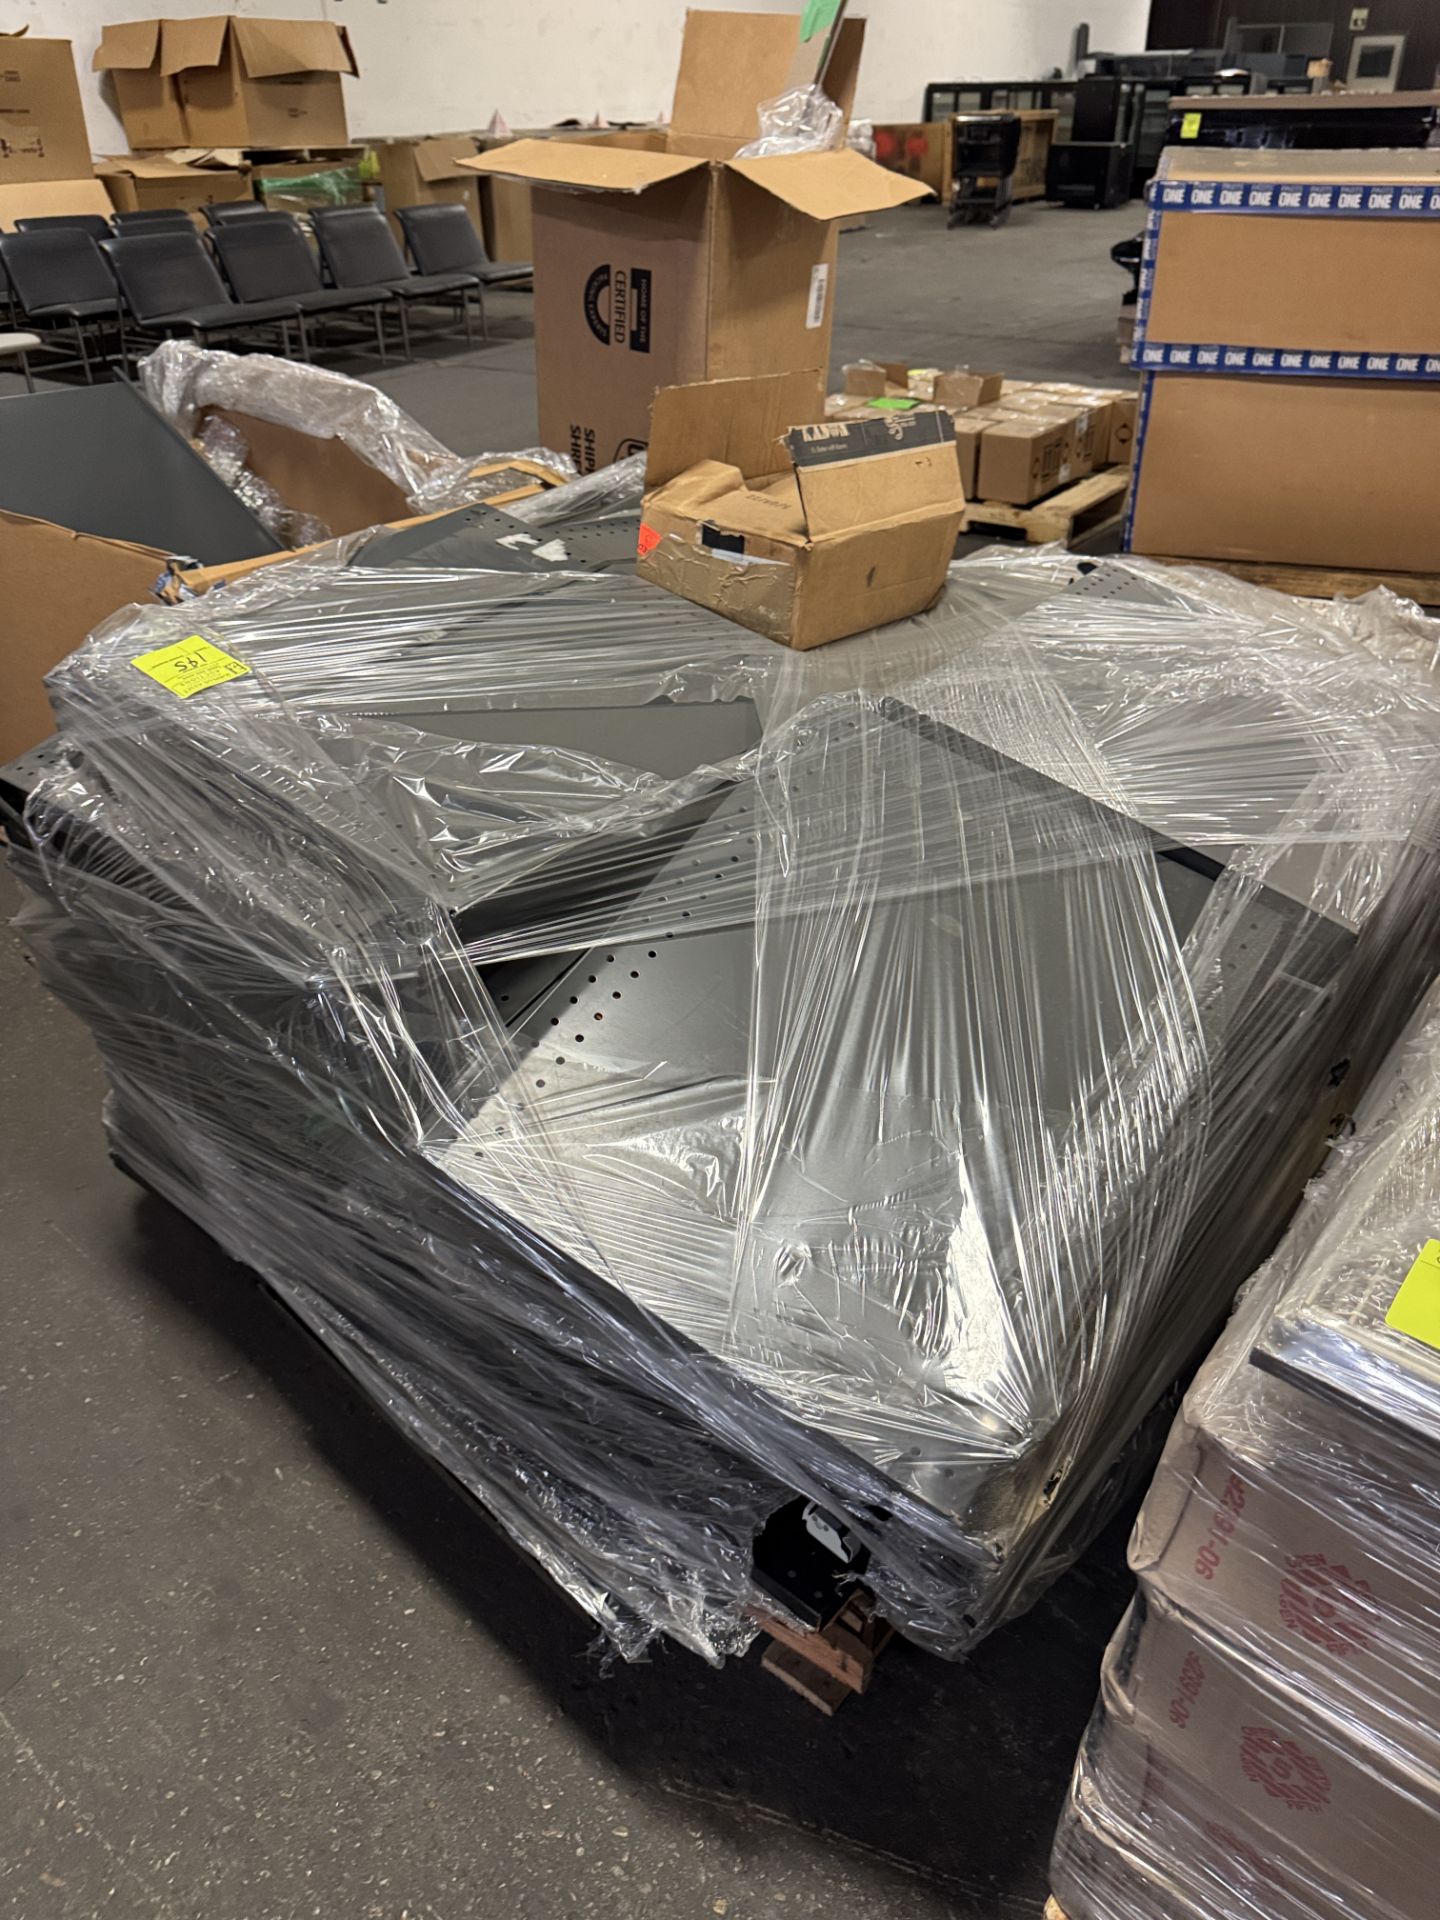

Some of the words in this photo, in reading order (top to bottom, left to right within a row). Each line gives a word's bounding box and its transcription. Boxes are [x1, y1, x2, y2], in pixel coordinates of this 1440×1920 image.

[1162, 188, 1185, 202] ONE
[1190, 189, 1214, 204] ONE
[1220, 190, 1242, 205] ONE
[1249, 191, 1272, 206] ONE
[1278, 192, 1302, 207] ONE
[1308, 192, 1332, 208] ONE
[1338, 193, 1362, 208] ONE
[1368, 194, 1392, 209] ONE
[1399, 194, 1423, 210] ONE
[640, 279, 648, 308] HOME
[614, 270, 627, 344] CERTIFIED
[640, 310, 647, 324] OF
[639, 326, 647, 343] THE
[1142, 349, 1164, 362] ONE
[1169, 350, 1191, 363] ONE
[1197, 351, 1218, 364] ONE
[1224, 352, 1246, 365] ONE
[1252, 353, 1274, 366] ONE
[1280, 354, 1302, 368] ONE
[1308, 355, 1331, 368] ONE
[1338, 356, 1360, 370] ONE
[1367, 357, 1389, 371] ONE
[1395, 358, 1418, 371] ONE
[1425, 359, 1440, 372] ON
